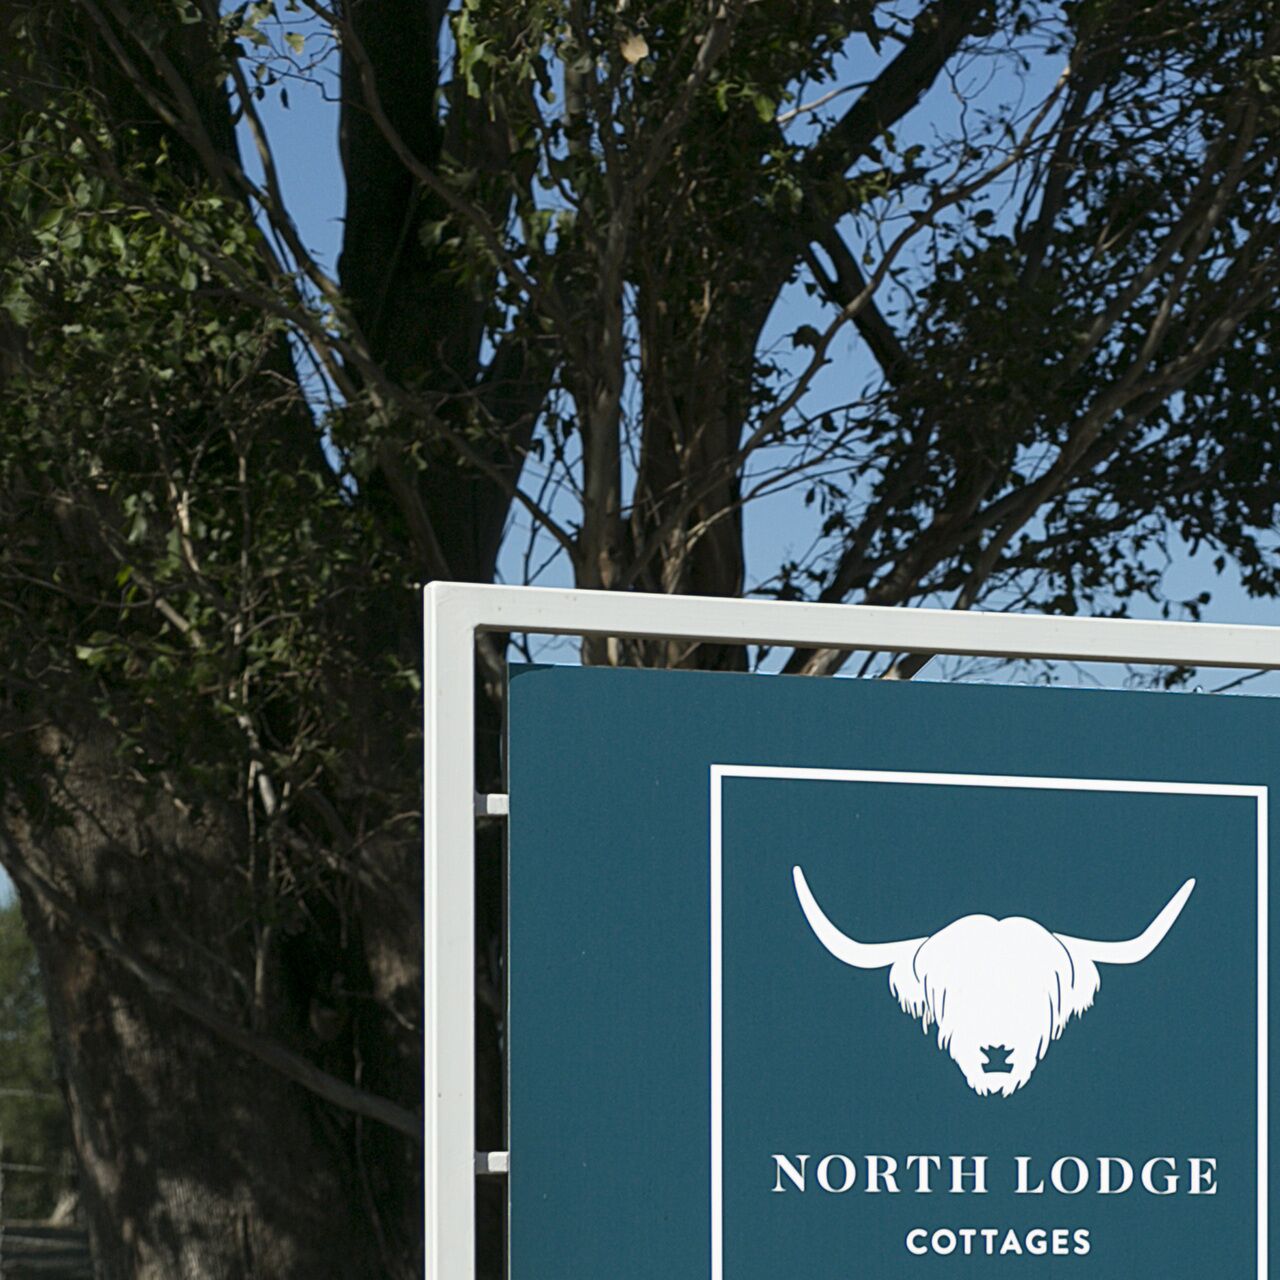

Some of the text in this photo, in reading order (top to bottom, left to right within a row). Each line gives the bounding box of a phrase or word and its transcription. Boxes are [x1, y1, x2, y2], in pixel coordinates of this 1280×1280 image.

[771, 1154, 1217, 1195] NORTH LODGE
[906, 1228, 1091, 1255] COTTAGES
